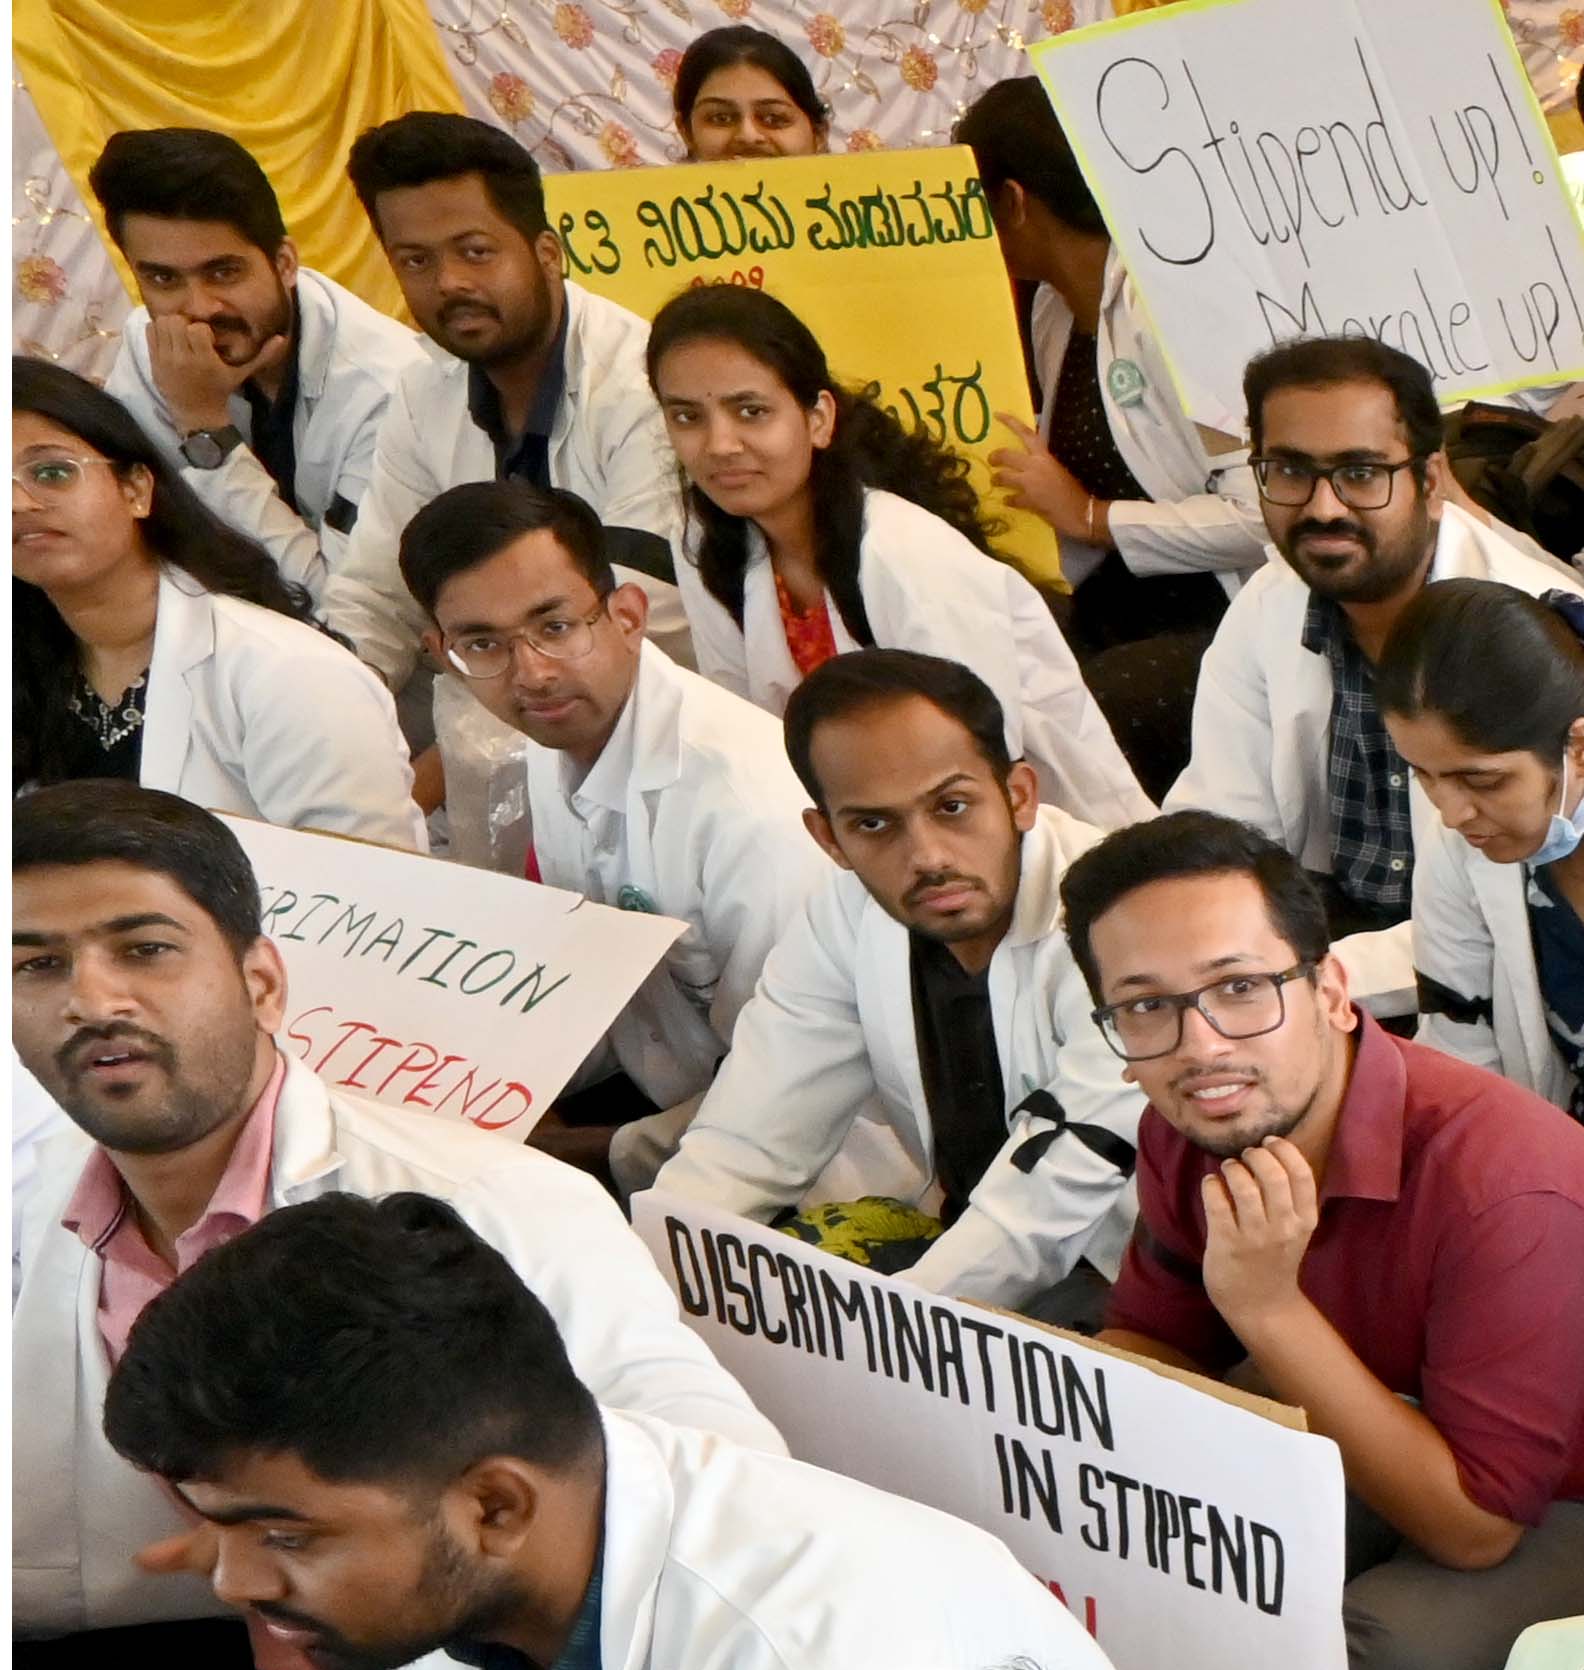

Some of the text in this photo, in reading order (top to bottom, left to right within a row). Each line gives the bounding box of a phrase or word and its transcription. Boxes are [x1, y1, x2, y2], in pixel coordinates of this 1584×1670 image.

[1097, 38, 1544, 267] Stipend up!
[286, 1006, 533, 1131] STIPEND
[664, 1214, 1116, 1452] DISCRIMINATION
[994, 1434, 1063, 1535] IN
[1079, 1463, 1285, 1617] STIPEND
